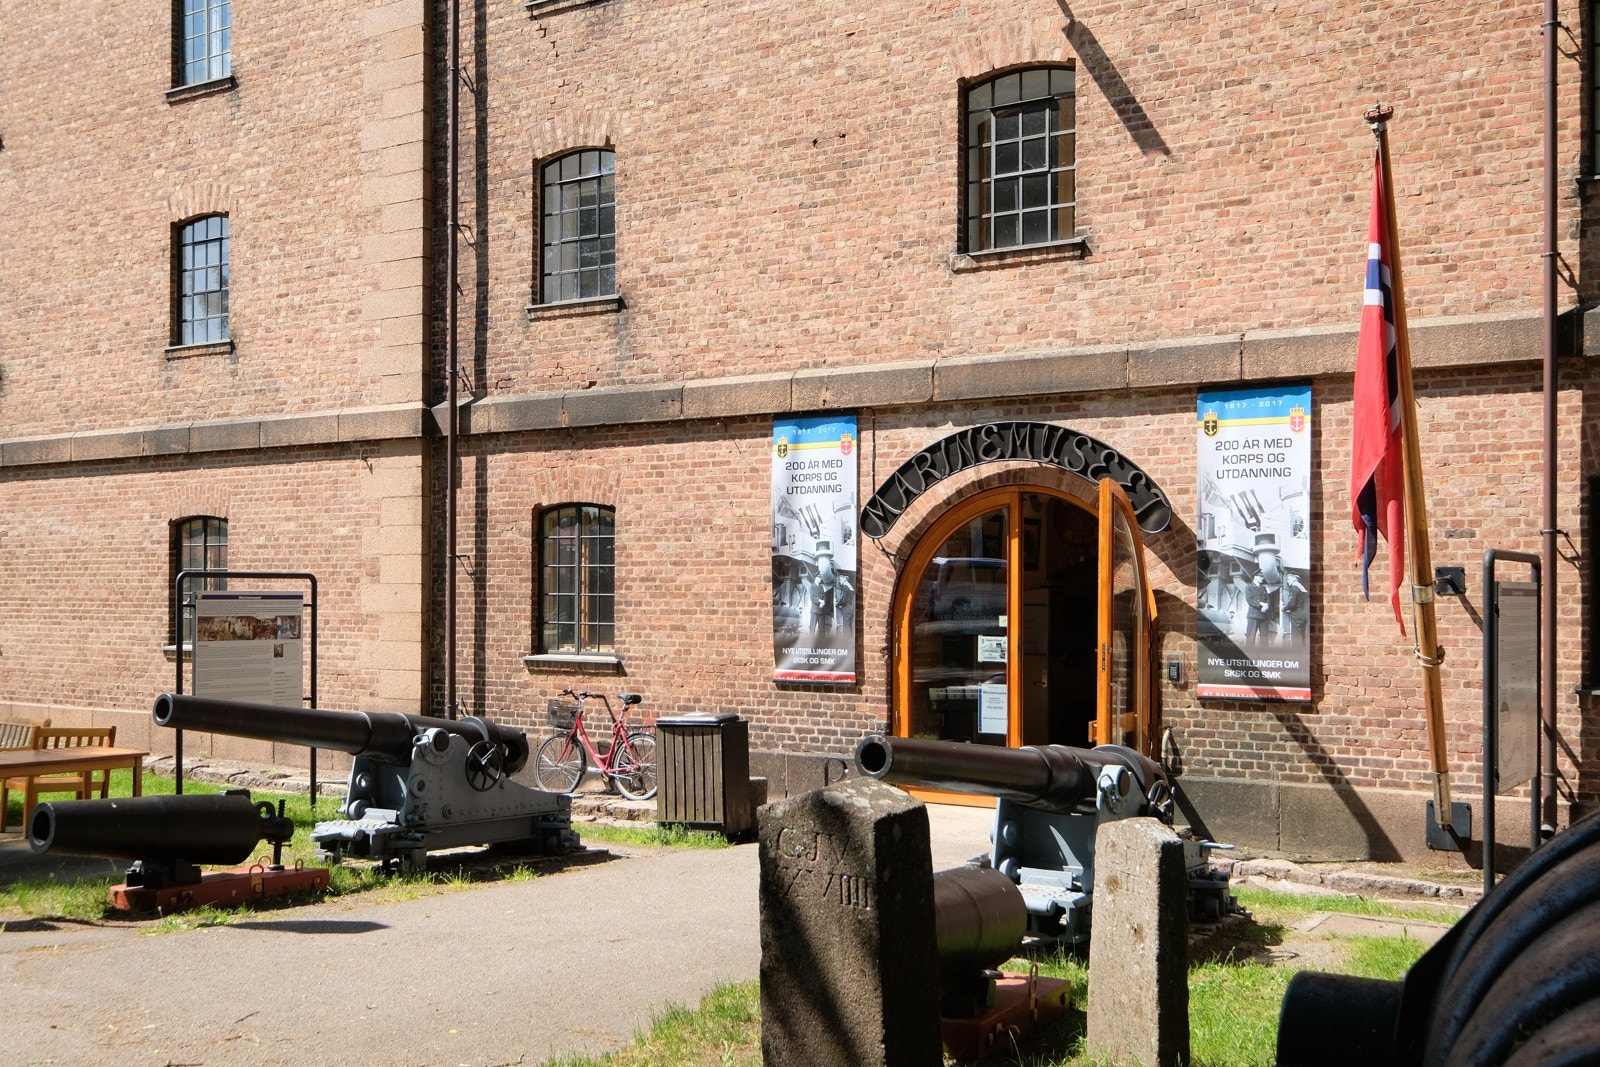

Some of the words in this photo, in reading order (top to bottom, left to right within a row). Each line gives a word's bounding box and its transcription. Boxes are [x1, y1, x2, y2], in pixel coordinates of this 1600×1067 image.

[1259, 400, 1283, 408] 2017
[1215, 440, 1239, 451] 200
[1243, 437, 1260, 450] ÅR
[1264, 438, 1293, 449] MED
[1222, 453, 1264, 465] KORPS
[1267, 453, 1285, 463] OG
[785, 461, 806, 471] 200
[808, 459, 820, 469] ÅR
[822, 459, 843, 469] MED
[791, 472, 822, 483] KORPS
[824, 471, 838, 481] OG
[1216, 467, 1292, 480] UTDANNING
[786, 484, 842, 495] UTDANNING
[782, 647, 795, 655] NYE
[795, 647, 837, 656] UTSTILLINGER
[837, 648, 848, 656] OM
[793, 656, 808, 664] SKSK
[820, 657, 835, 665] SMK
[1207, 658, 1225, 666] NYE
[1226, 658, 1283, 668] UTSTILLINGER
[1284, 660, 1299, 669] OM
[1224, 669, 1247, 678] SKSK
[1248, 670, 1260, 678] OG
[1261, 671, 1281, 679] SMK
